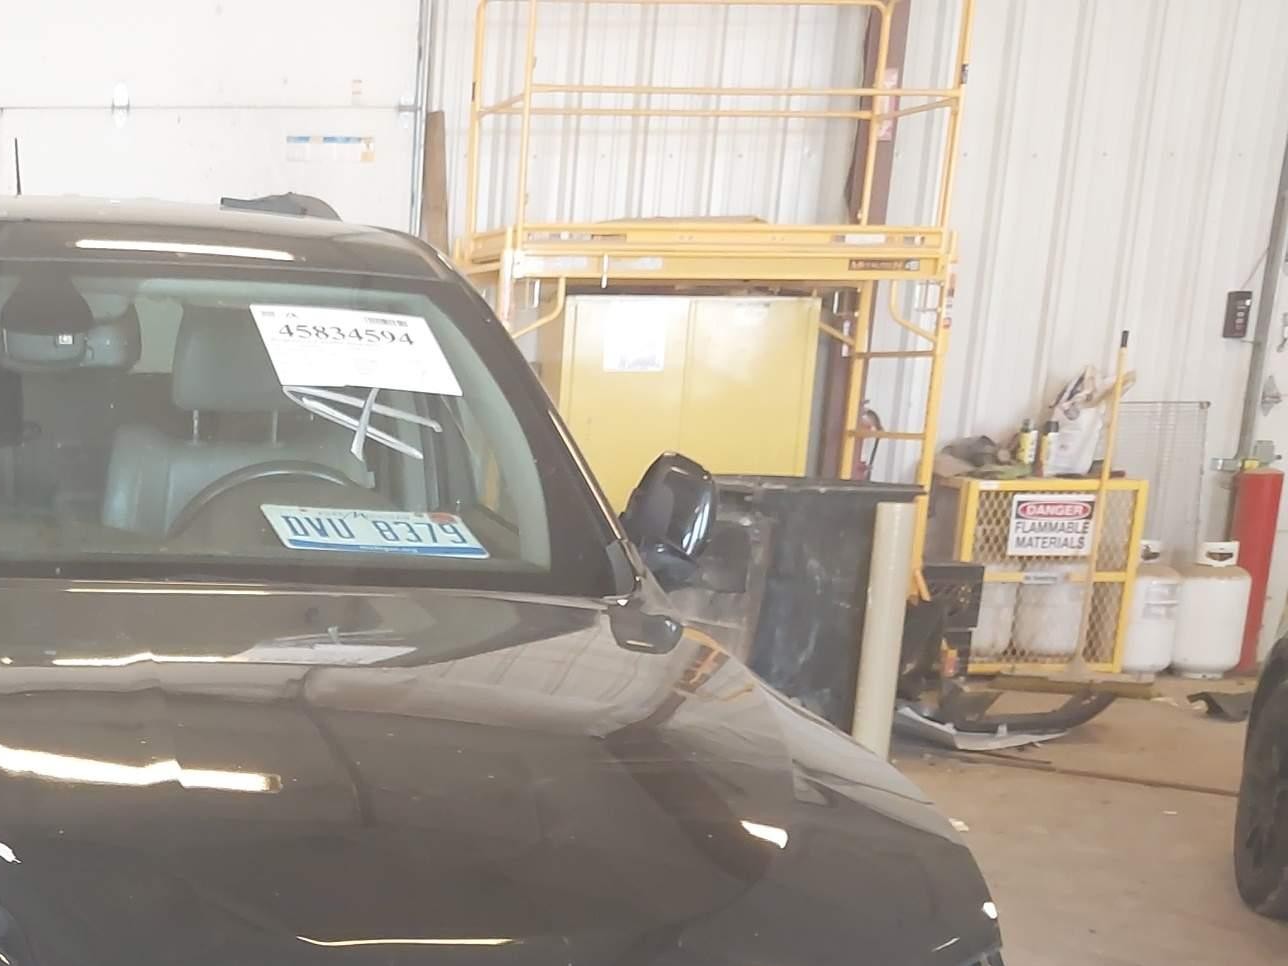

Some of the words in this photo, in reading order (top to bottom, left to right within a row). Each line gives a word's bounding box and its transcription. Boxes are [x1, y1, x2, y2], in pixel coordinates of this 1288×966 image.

[279, 323, 415, 346] 45834594
[1025, 503, 1083, 517] DANGER
[282, 515, 356, 540] DVU
[372, 520, 468, 544] 8379
[1015, 521, 1090, 534] FLAMMABLE
[1015, 536, 1085, 549] MATERIALS
